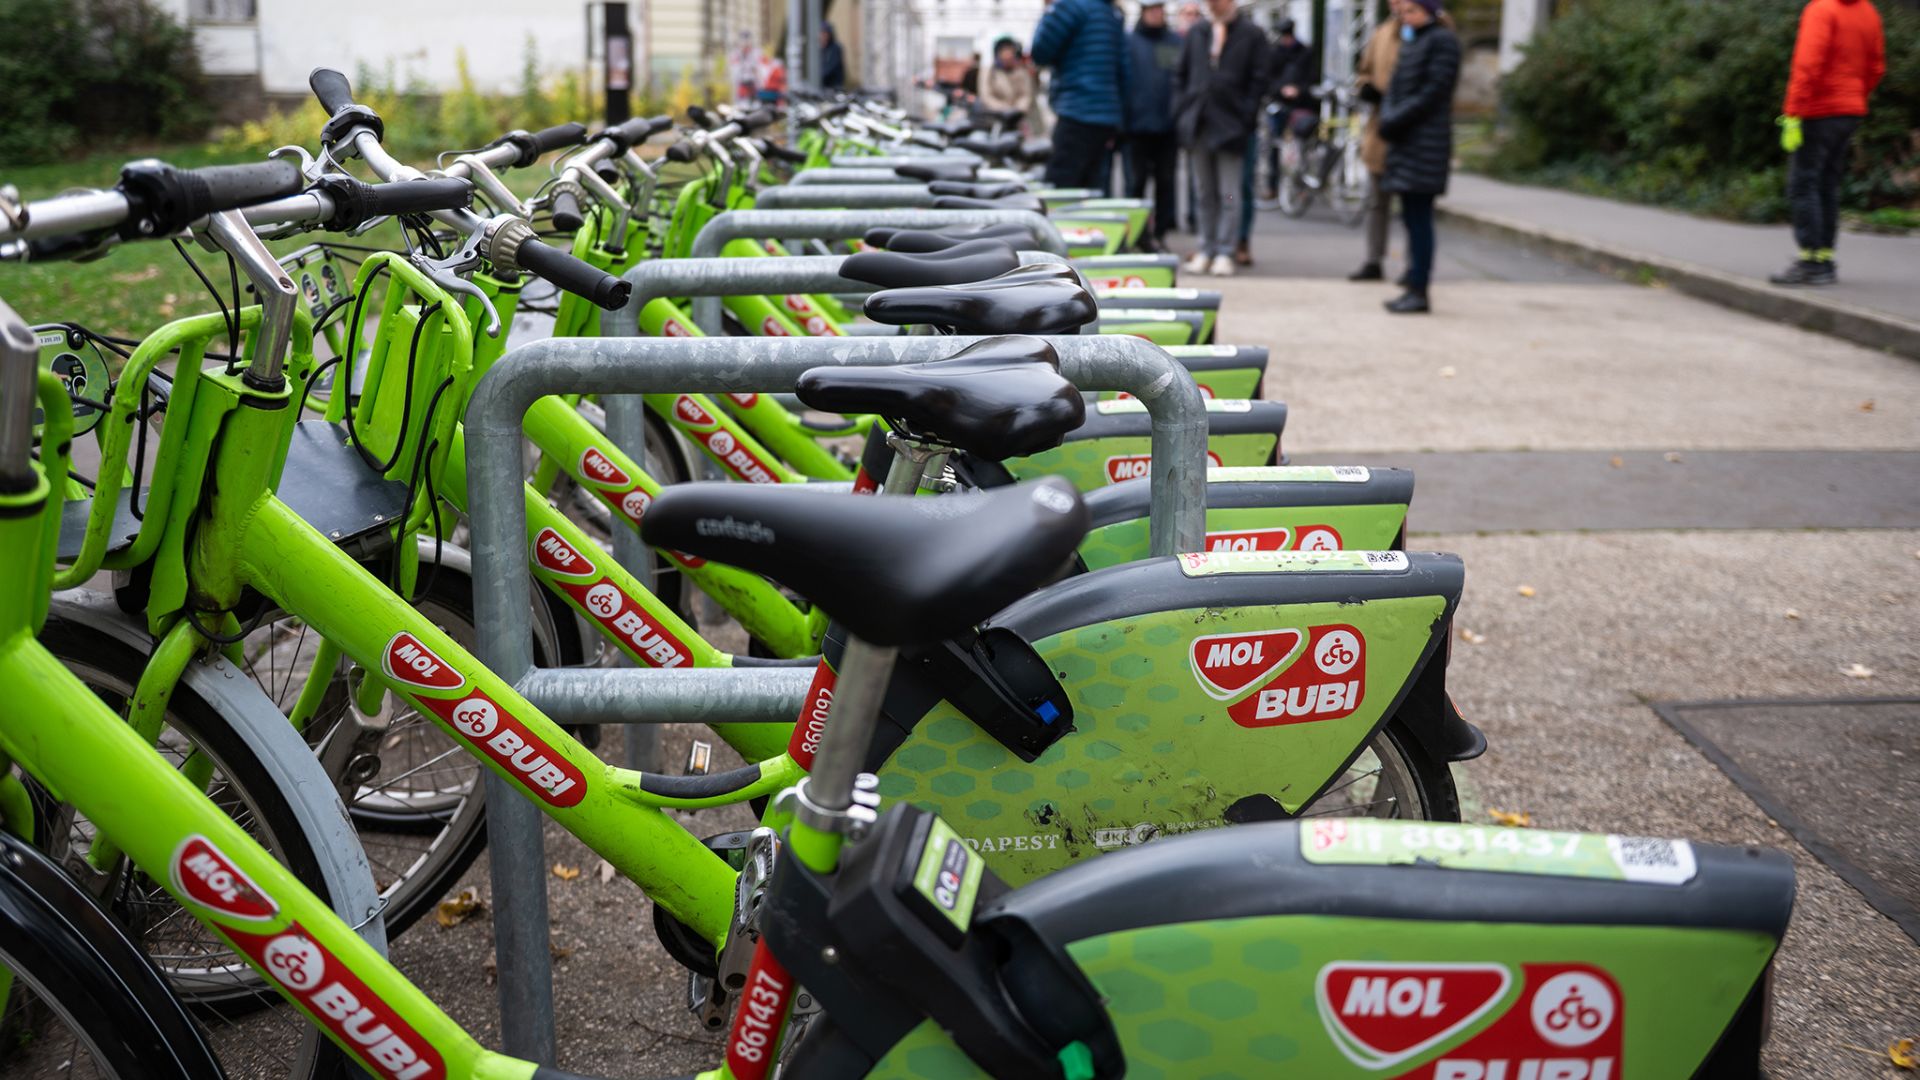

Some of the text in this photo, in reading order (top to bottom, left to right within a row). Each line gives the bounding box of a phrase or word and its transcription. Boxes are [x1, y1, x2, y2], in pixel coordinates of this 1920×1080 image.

[679, 399, 703, 421] MOL
[586, 453, 615, 478] MOL
[1115, 460, 1151, 480] MO
[541, 536, 577, 567] MOL
[612, 610, 686, 668] BUBI
[1204, 640, 1265, 669] MOL
[394, 643, 440, 679] MOL
[1255, 680, 1359, 720] BUBI
[486, 728, 576, 798] BUBI
[966, 834, 1059, 852] DAPEST
[183, 851, 239, 903] MOL
[735, 968, 783, 1062] 861437
[1341, 976, 1447, 1018] MOL
[310, 981, 432, 1080] BUBI
